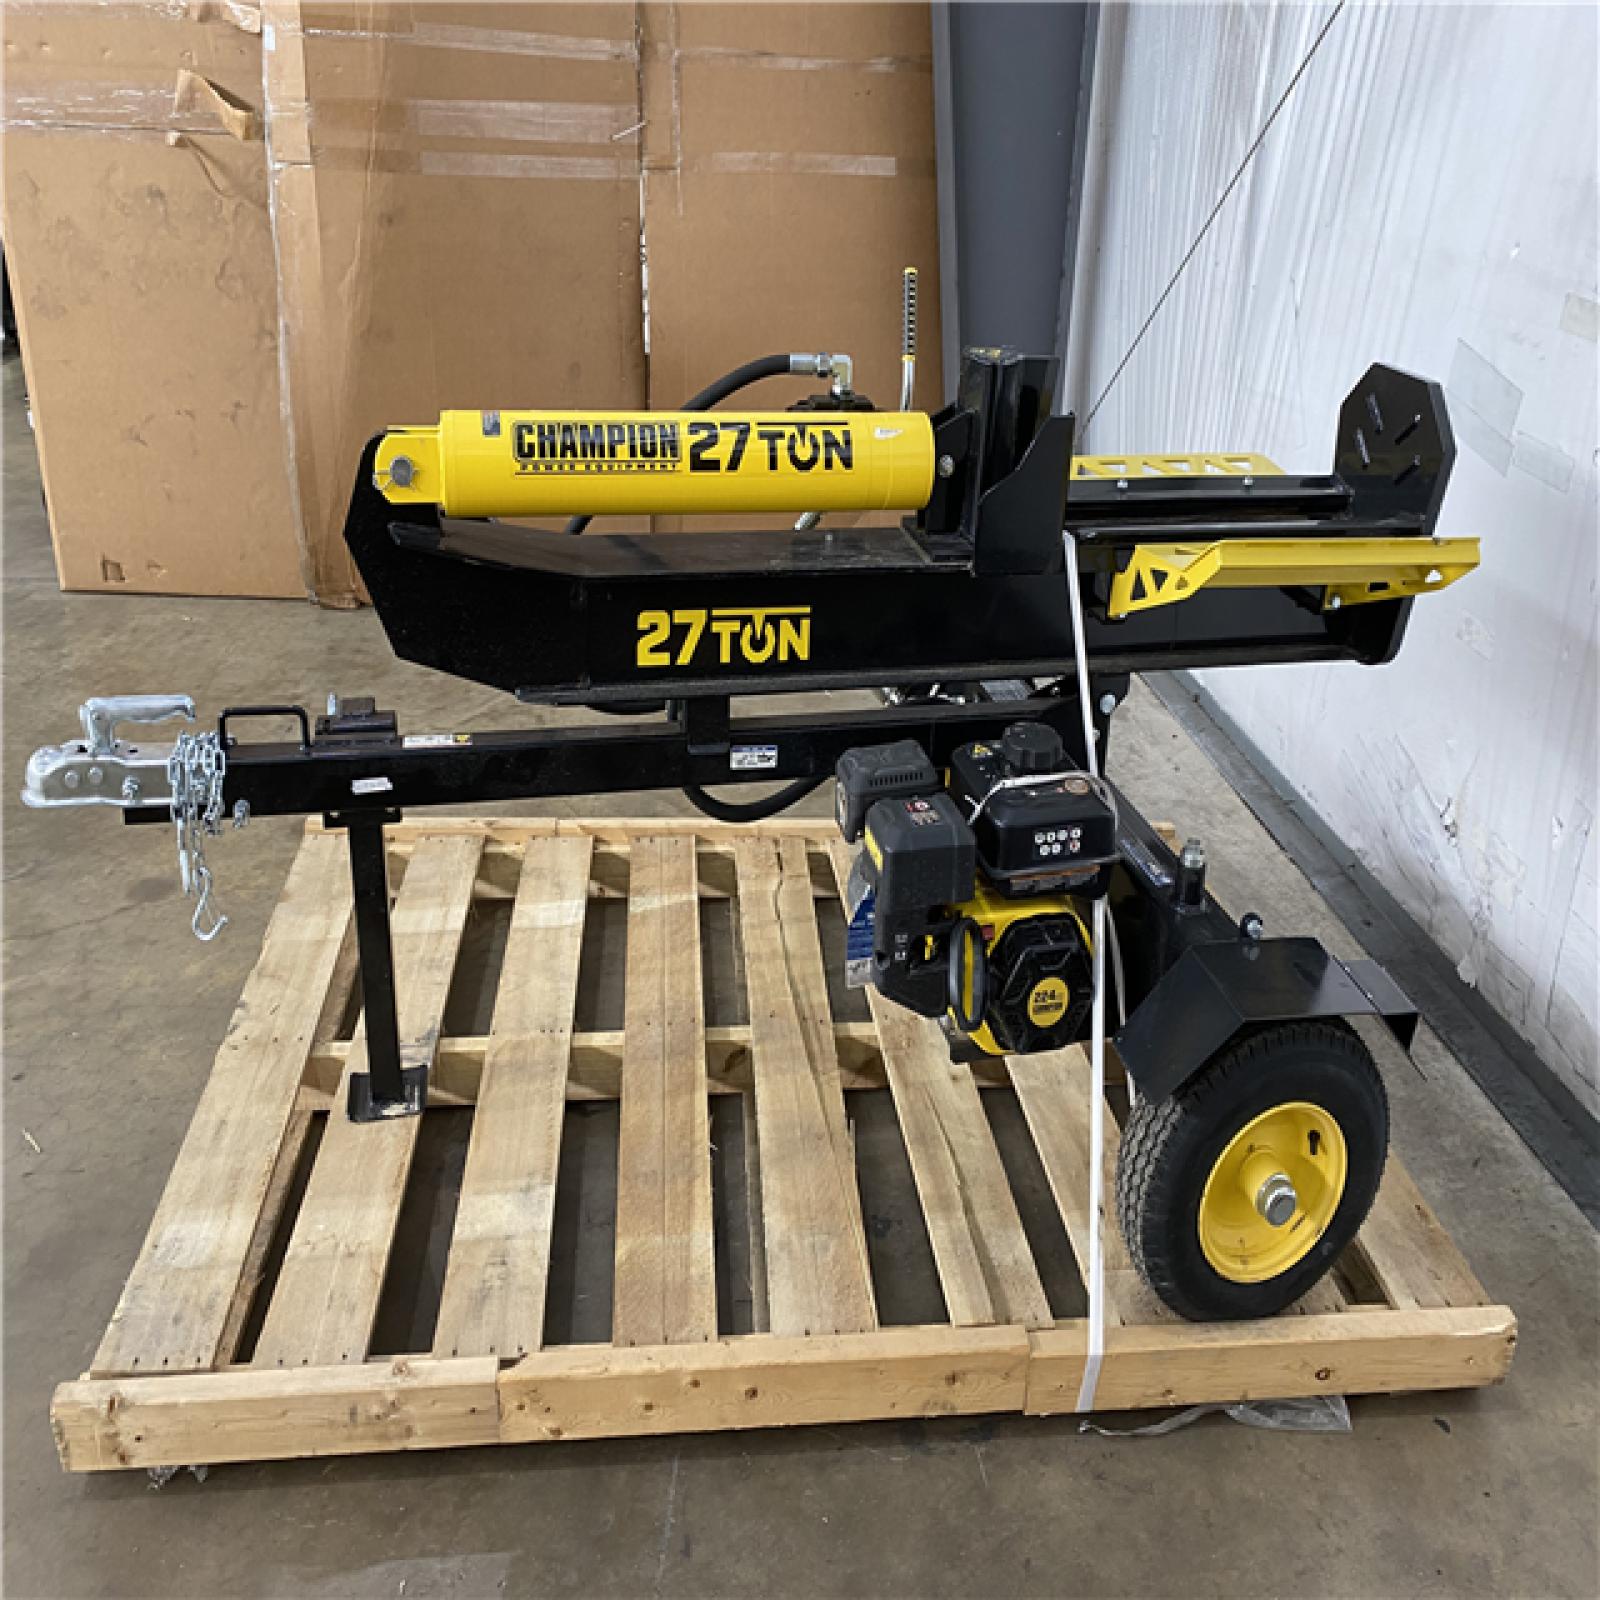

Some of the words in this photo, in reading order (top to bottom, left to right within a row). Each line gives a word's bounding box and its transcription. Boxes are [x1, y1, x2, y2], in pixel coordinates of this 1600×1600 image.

[515, 422, 679, 459] CHAMPION
[688, 422, 750, 472] 27
[757, 422, 853, 472] TON
[637, 609, 707, 666] 27
[711, 606, 811, 664] TON
